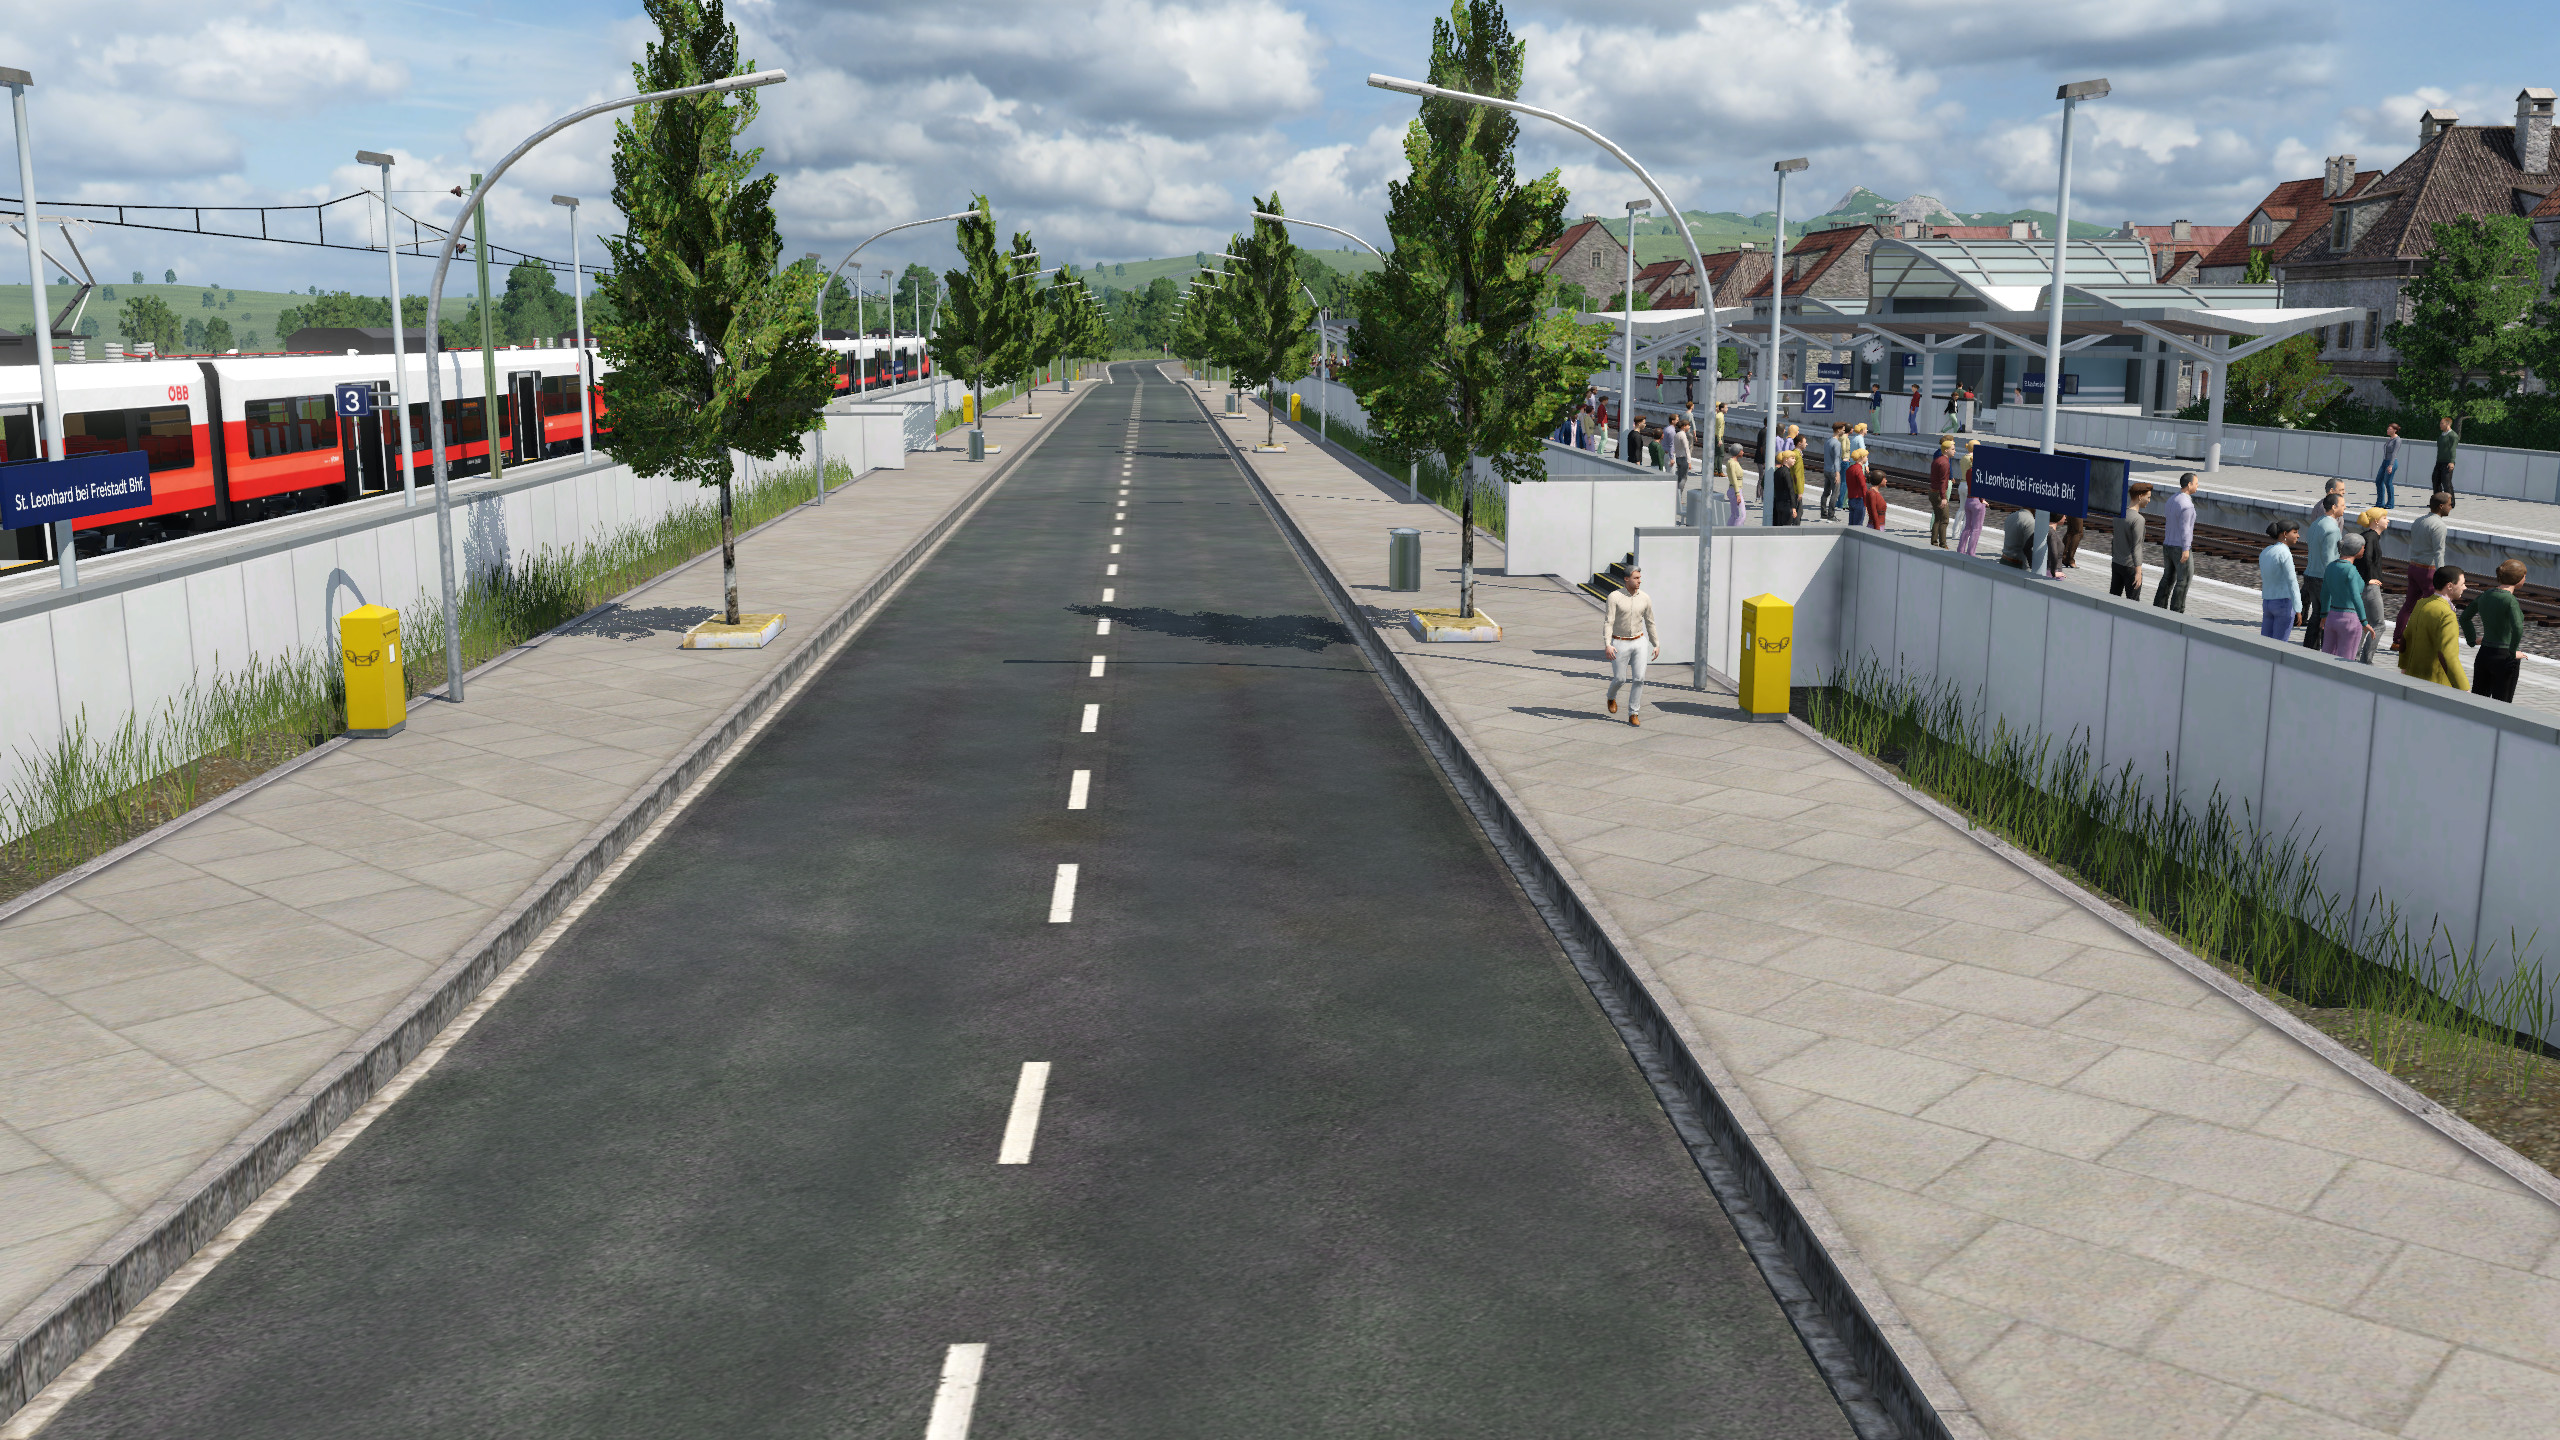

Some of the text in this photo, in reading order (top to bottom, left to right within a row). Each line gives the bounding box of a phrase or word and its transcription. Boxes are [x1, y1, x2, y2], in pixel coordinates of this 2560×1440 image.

[1907, 355, 1914, 366] 1
[345, 390, 360, 412] 3
[1812, 387, 1827, 409] 2
[15, 476, 146, 511] St. Leonhard bei Freistadt Bhf.
[1975, 469, 2076, 501] St. Leonhard bei Freistadt Bhf.
